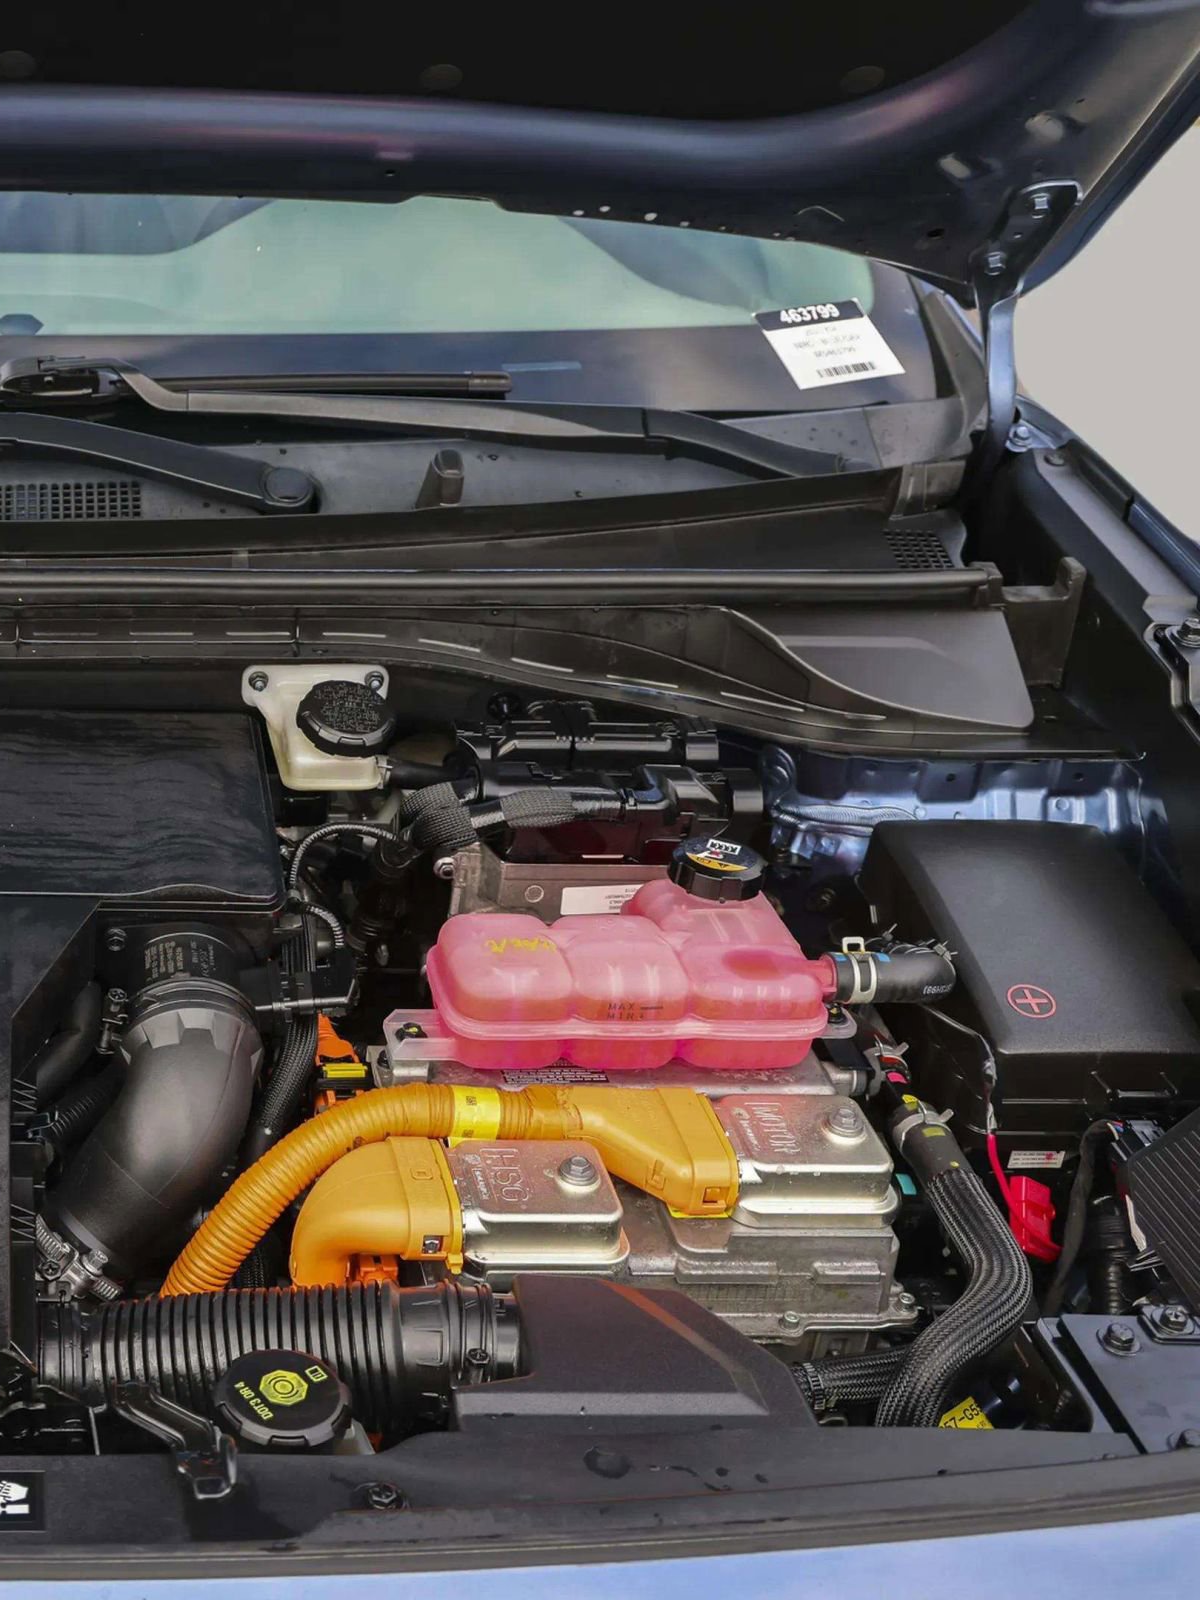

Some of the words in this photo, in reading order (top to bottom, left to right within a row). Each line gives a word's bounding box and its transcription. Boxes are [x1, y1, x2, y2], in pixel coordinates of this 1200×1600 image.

[780, 304, 840, 324] 463799
[608, 1002, 635, 1010] MAX
[234, 1381, 244, 1389] 4
[239, 1387, 255, 1400] OR
[250, 1398, 274, 1420] DOT3
